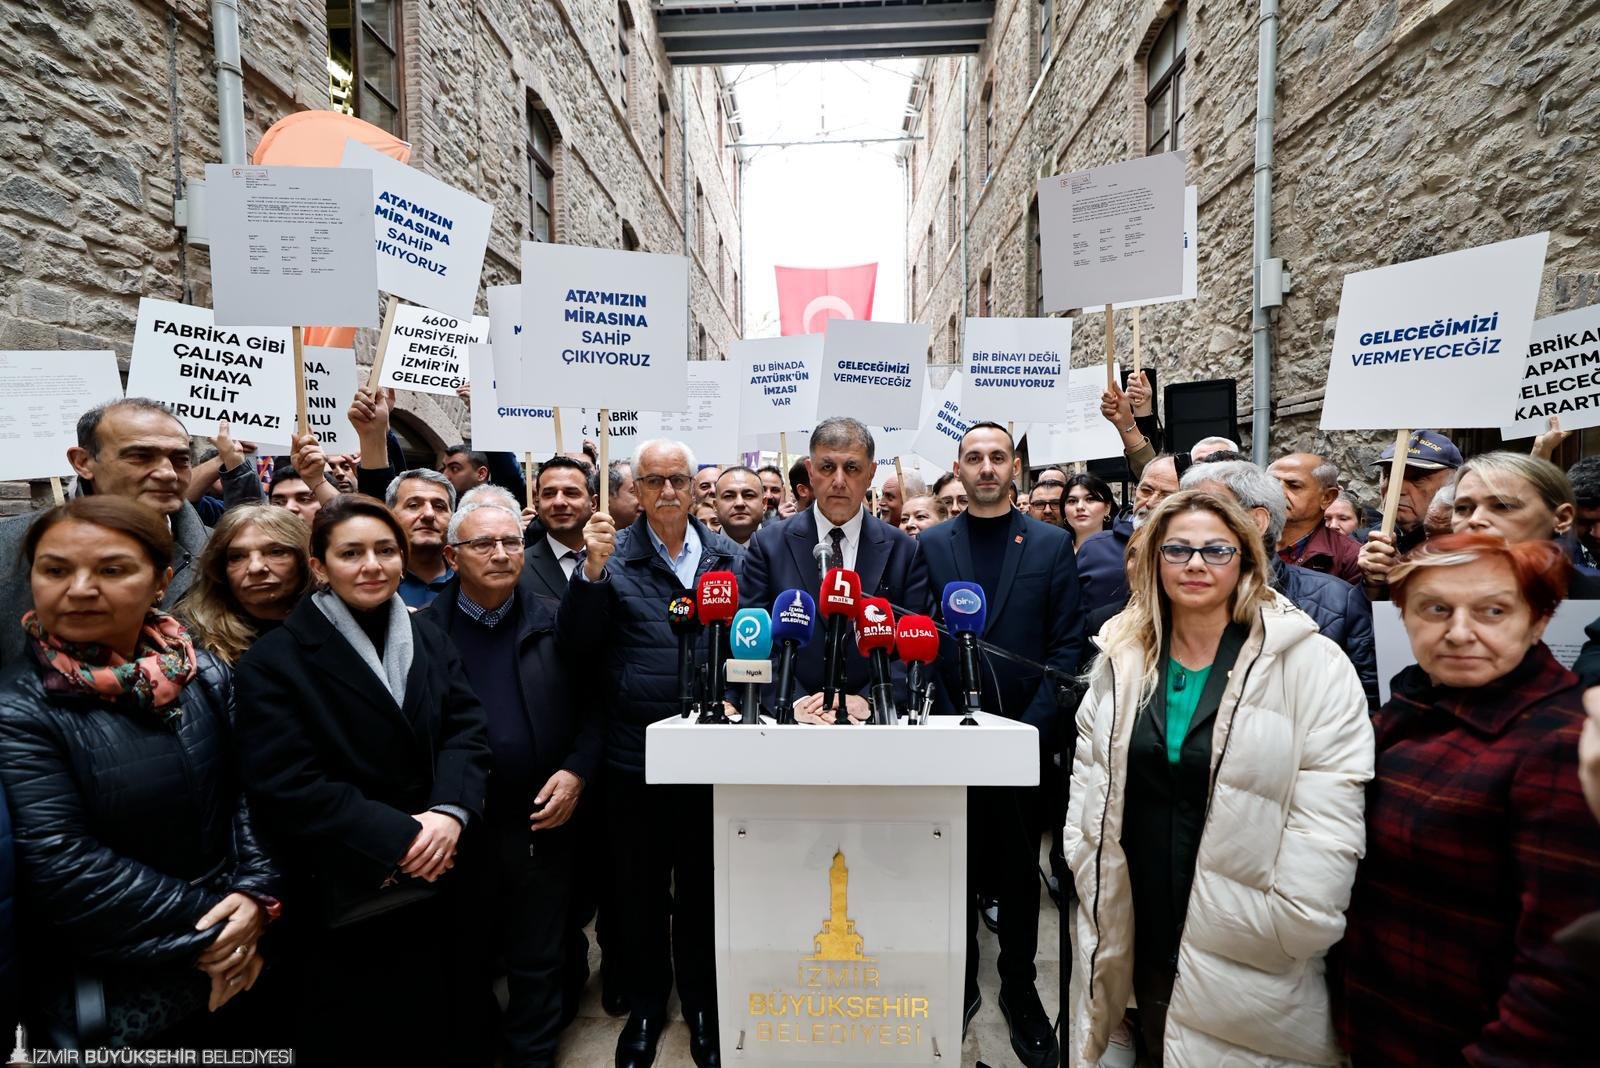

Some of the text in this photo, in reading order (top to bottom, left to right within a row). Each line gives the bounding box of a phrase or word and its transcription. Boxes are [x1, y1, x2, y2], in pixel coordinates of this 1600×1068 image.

[379, 191, 454, 230] ATA’MIZIN
[374, 204, 450, 246] MİRASINA
[387, 227, 433, 252] SAHİP
[376, 240, 448, 276] IKIYORUZ
[565, 289, 647, 308] ATA’MIZIN
[422, 315, 458, 329] 4600
[564, 307, 648, 328] MİRASINA
[154, 320, 286, 354] FABRİKA GİBİ
[394, 325, 479, 345] KURSİYERİN
[582, 330, 631, 346] SAHİP
[1360, 312, 1499, 346] GELECEĞİMİZİ
[173, 344, 263, 369] ÇALIŞAN
[408, 342, 458, 360] EMEĞİ,
[562, 350, 650, 367] ÇIKIYORUZ
[972, 351, 1060, 362] BİR BİNAYI DEĞİL
[1352, 336, 1502, 366] VERMEYECEĞİZ
[180, 362, 252, 386] BİNAYA
[401, 354, 460, 374] İZMİR'İN
[753, 360, 804, 372] BU BİNADA
[838, 360, 910, 374] GELECEĞİMİZİ
[970, 364, 1060, 375] BİNLERCE HAYALİ
[1524, 350, 1600, 379] APATM
[750, 372, 809, 384] ATATÜRK’ÜN
[834, 372, 912, 388] VERMEYECEĞİZ
[974, 379, 1055, 388] SAVUNUYORUZ
[1519, 368, 1600, 400] ELECEĞ
[190, 384, 240, 404] KİLİT
[764, 385, 796, 395] İMZASI
[772, 398, 791, 406] VAR
[944, 400, 958, 413] BİR
[158, 400, 280, 429] RULAMAZ!
[598, 410, 638, 422] BRİK
[937, 410, 971, 432] BİNLERC
[864, 623, 892, 634] anka
[900, 629, 934, 638] ULUSAL
[796, 965, 881, 988] İZMİR
[749, 988, 929, 1019] BÜYÜKŞEHİR
[757, 1021, 922, 1046] BELEDİYESİ
